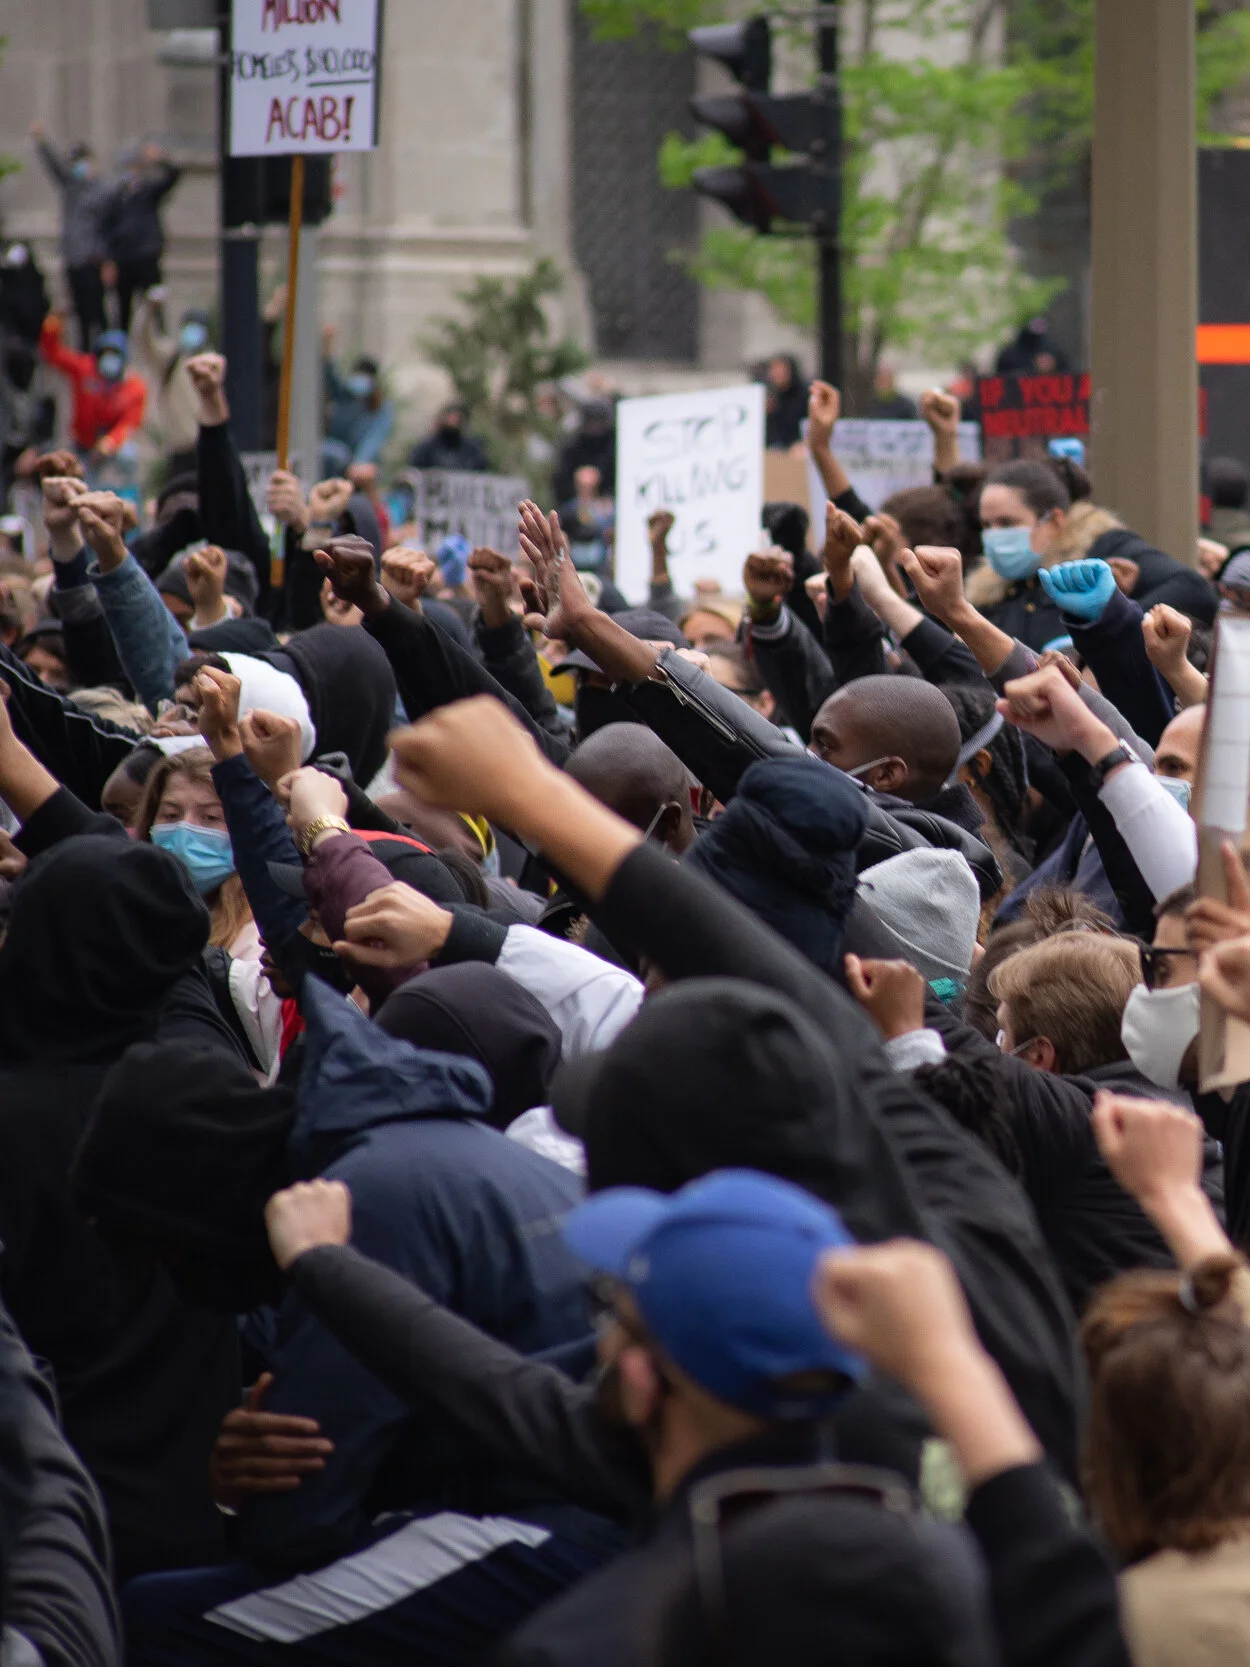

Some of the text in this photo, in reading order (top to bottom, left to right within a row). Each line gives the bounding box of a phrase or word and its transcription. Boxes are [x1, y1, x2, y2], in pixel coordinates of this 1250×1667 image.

[265, 96, 355, 144] ACAB!
[979, 376, 1006, 406] IF
[1017, 373, 1073, 404] YOU
[642, 402, 748, 465] STOP
[634, 455, 749, 507] KILLING
